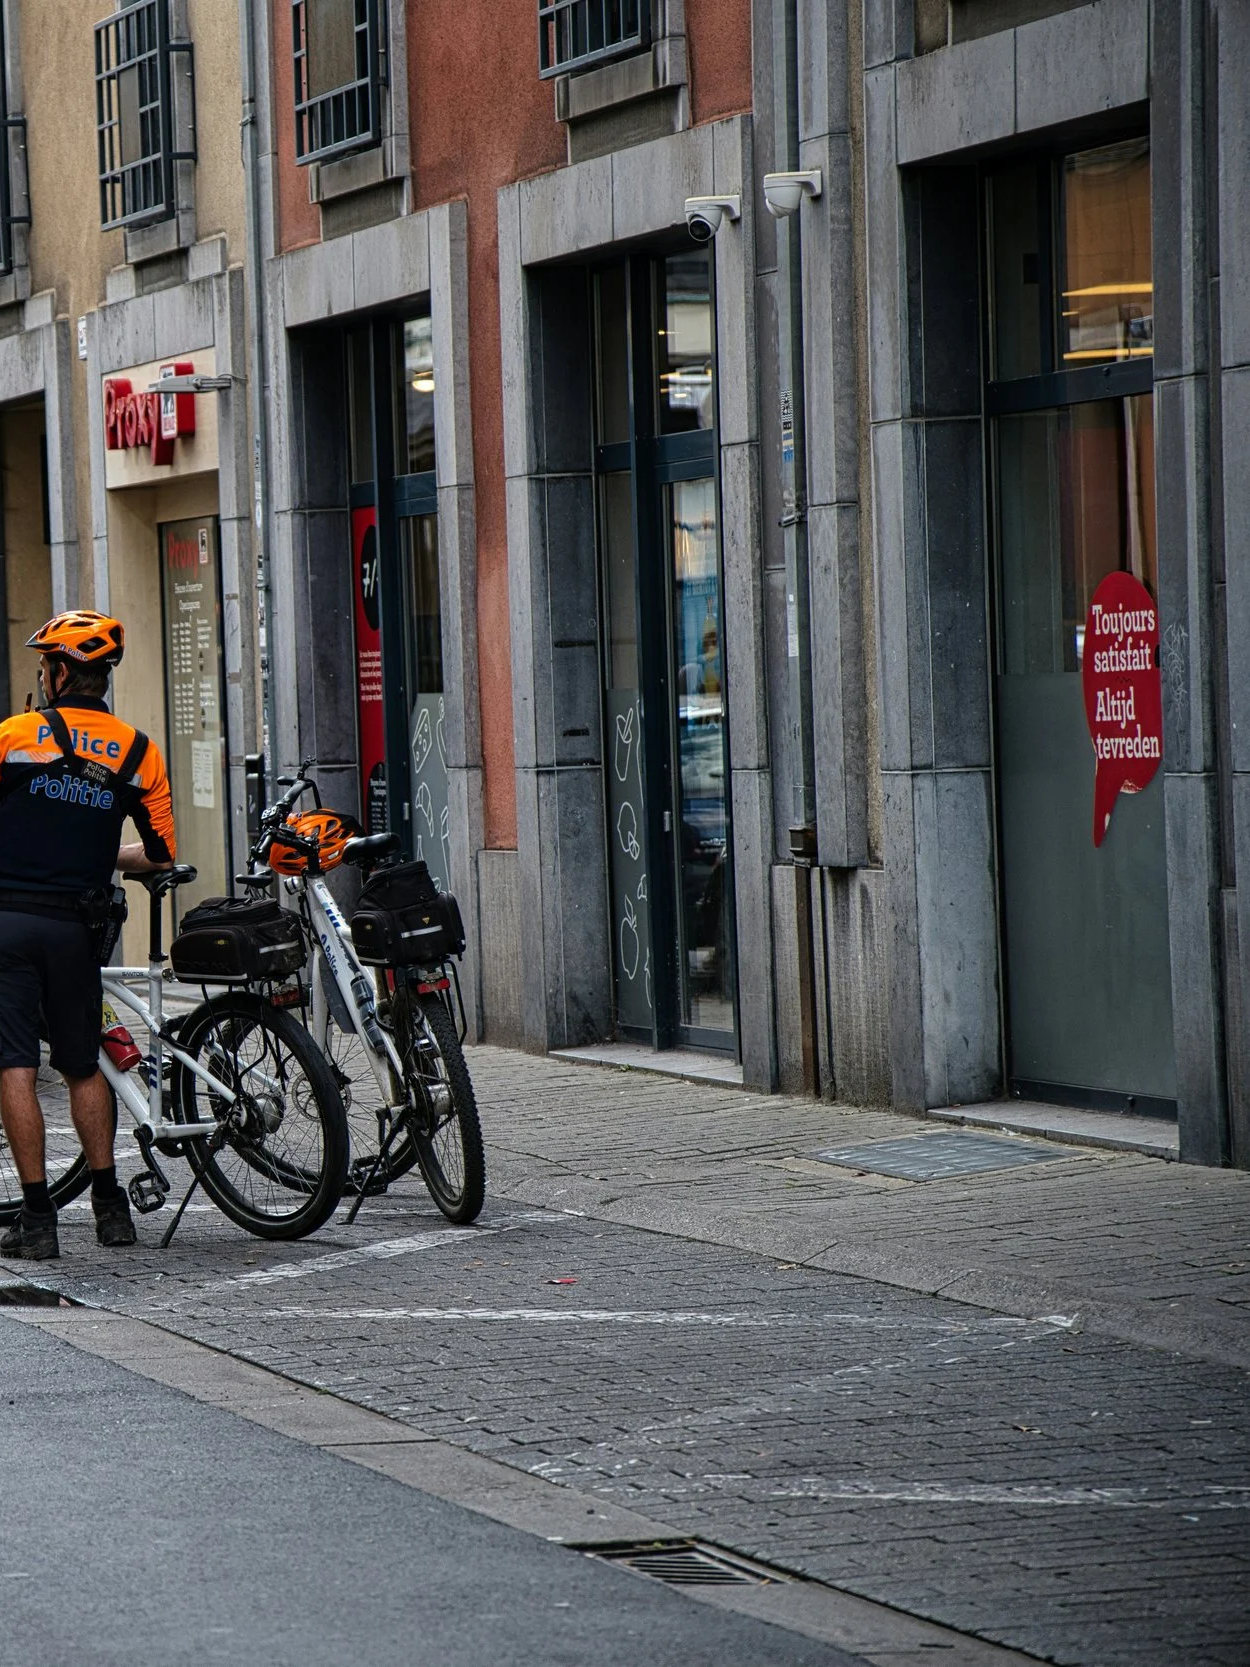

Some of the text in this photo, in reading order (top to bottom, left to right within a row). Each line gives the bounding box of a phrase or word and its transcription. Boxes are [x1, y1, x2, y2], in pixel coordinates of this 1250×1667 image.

[104, 380, 158, 465] Proxy
[167, 531, 198, 581] Proxy
[1092, 603, 1155, 642] Toujours
[67, 647, 88, 662] Police
[1094, 637, 1151, 673] satisfait
[1095, 686, 1136, 729] Altijd
[37, 725, 121, 758] Plice
[1097, 724, 1160, 760] tevreden
[83, 767, 106, 783] Politie
[86, 761, 107, 775] Police
[30, 773, 114, 809] Politie
